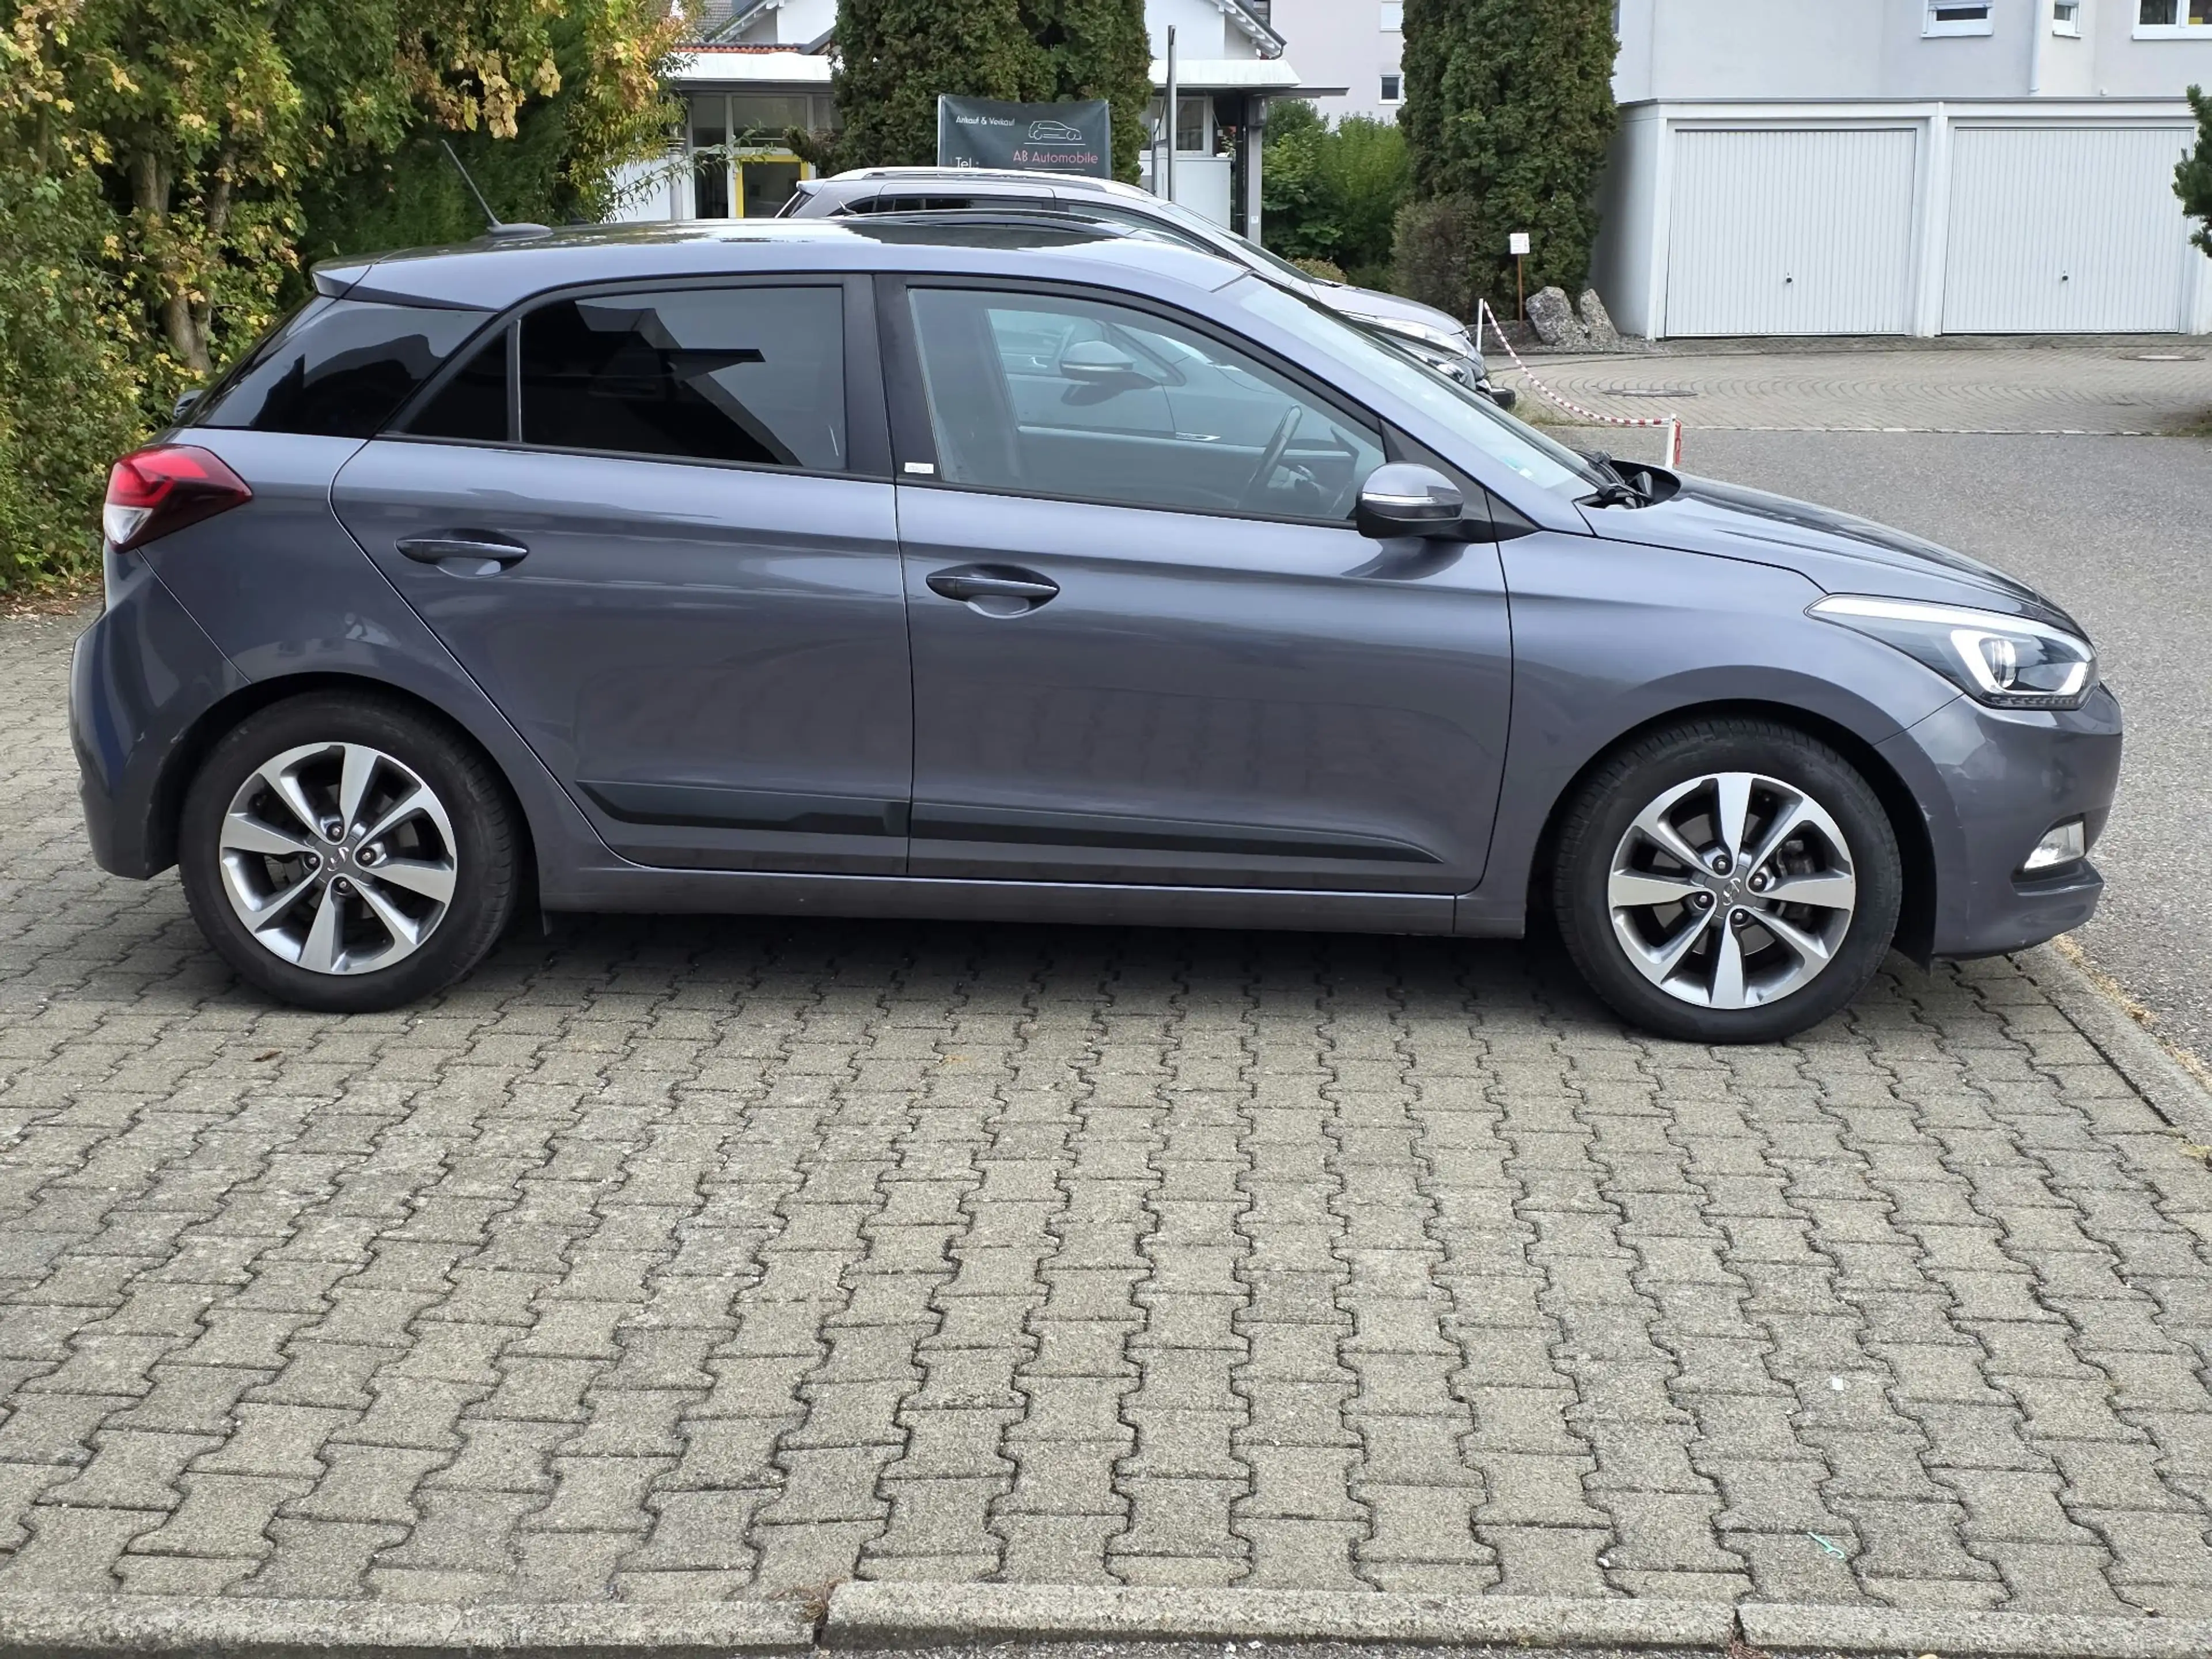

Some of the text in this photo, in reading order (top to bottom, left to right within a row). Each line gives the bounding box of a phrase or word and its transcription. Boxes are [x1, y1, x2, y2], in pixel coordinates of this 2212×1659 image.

[956, 115, 1015, 126] Ankauf & Verkauf
[1013, 150, 1099, 164] AB Automobile
